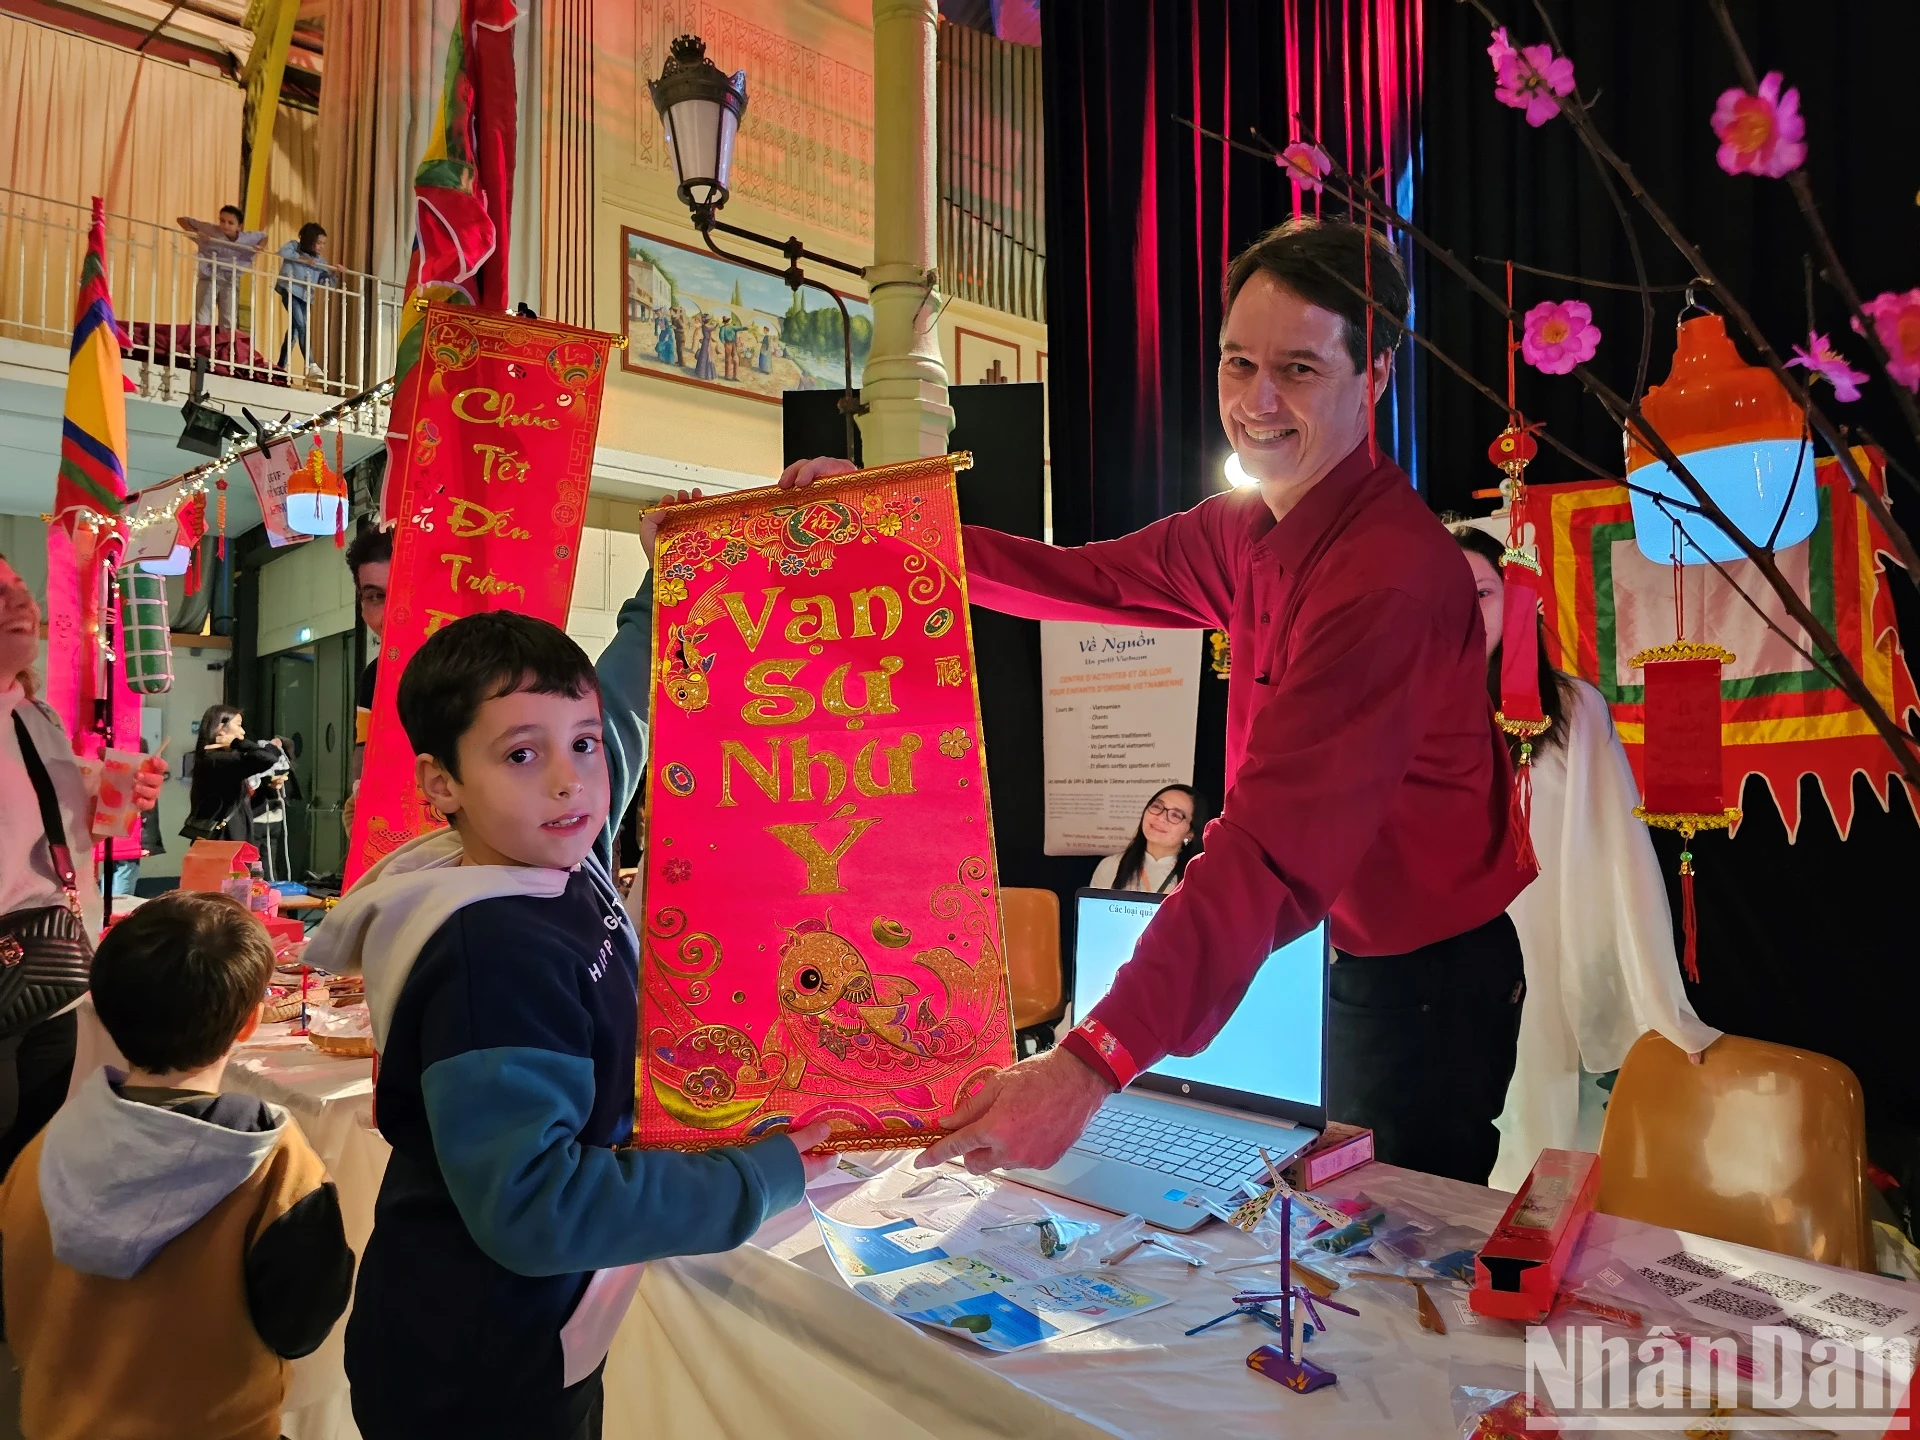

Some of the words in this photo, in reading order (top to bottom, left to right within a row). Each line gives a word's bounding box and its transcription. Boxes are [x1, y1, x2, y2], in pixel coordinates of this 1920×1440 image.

[451, 387, 562, 430] Chúc
[473, 443, 531, 484] Tết
[447, 496, 532, 540] Đến
[440, 553, 526, 606] Trăm
[718, 585, 903, 655] Vạn
[1078, 636, 1097, 653] Về
[1101, 630, 1156, 653] Nguồn
[1116, 654, 1147, 662] Vietnam
[741, 655, 904, 730] Sự
[715, 732, 923, 807] Như
[762, 802, 883, 895] Ý
[1108, 903, 1123, 913] Các
[1124, 905, 1138, 916] loại
